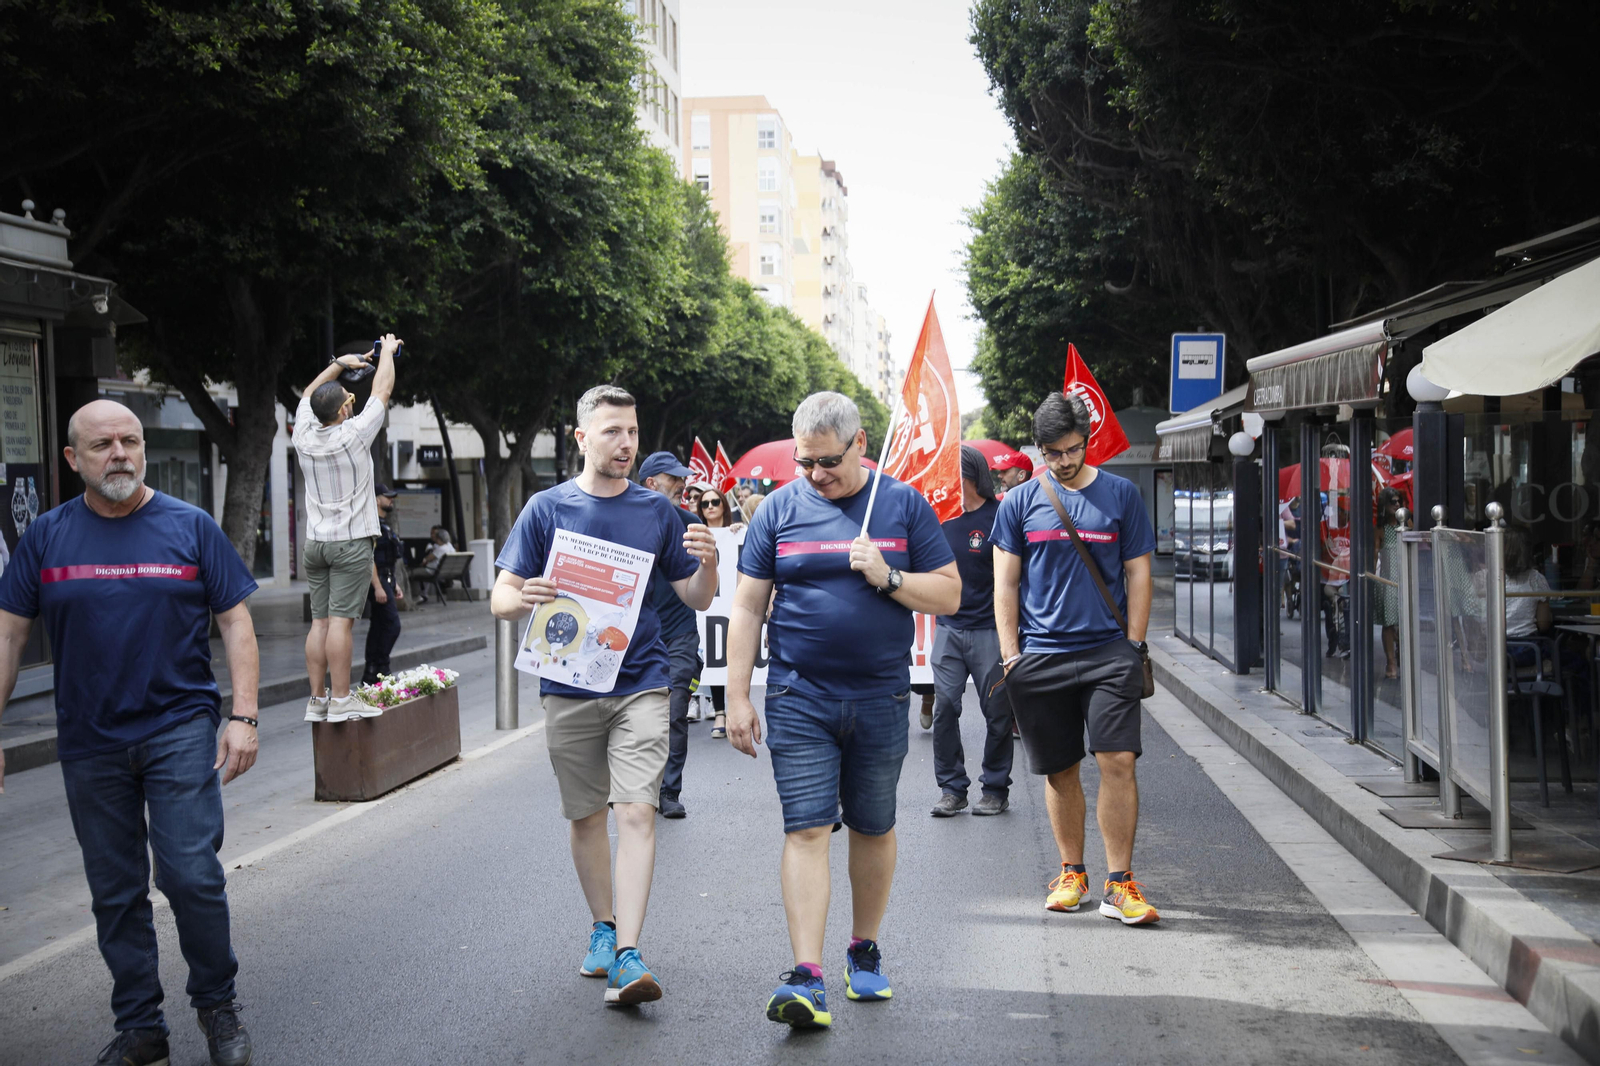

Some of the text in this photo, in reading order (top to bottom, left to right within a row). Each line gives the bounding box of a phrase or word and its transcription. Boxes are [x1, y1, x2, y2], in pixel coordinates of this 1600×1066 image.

[558, 534, 650, 563] SIN MEDIOS PARA PODER HACER
[573, 545, 586, 553] UNA
[586, 548, 600, 556] RCP
[608, 554, 634, 565] CALIDAD
[557, 556, 565, 567] 5
[95, 566, 182, 576] DIGNIDAD BOMBEROS
